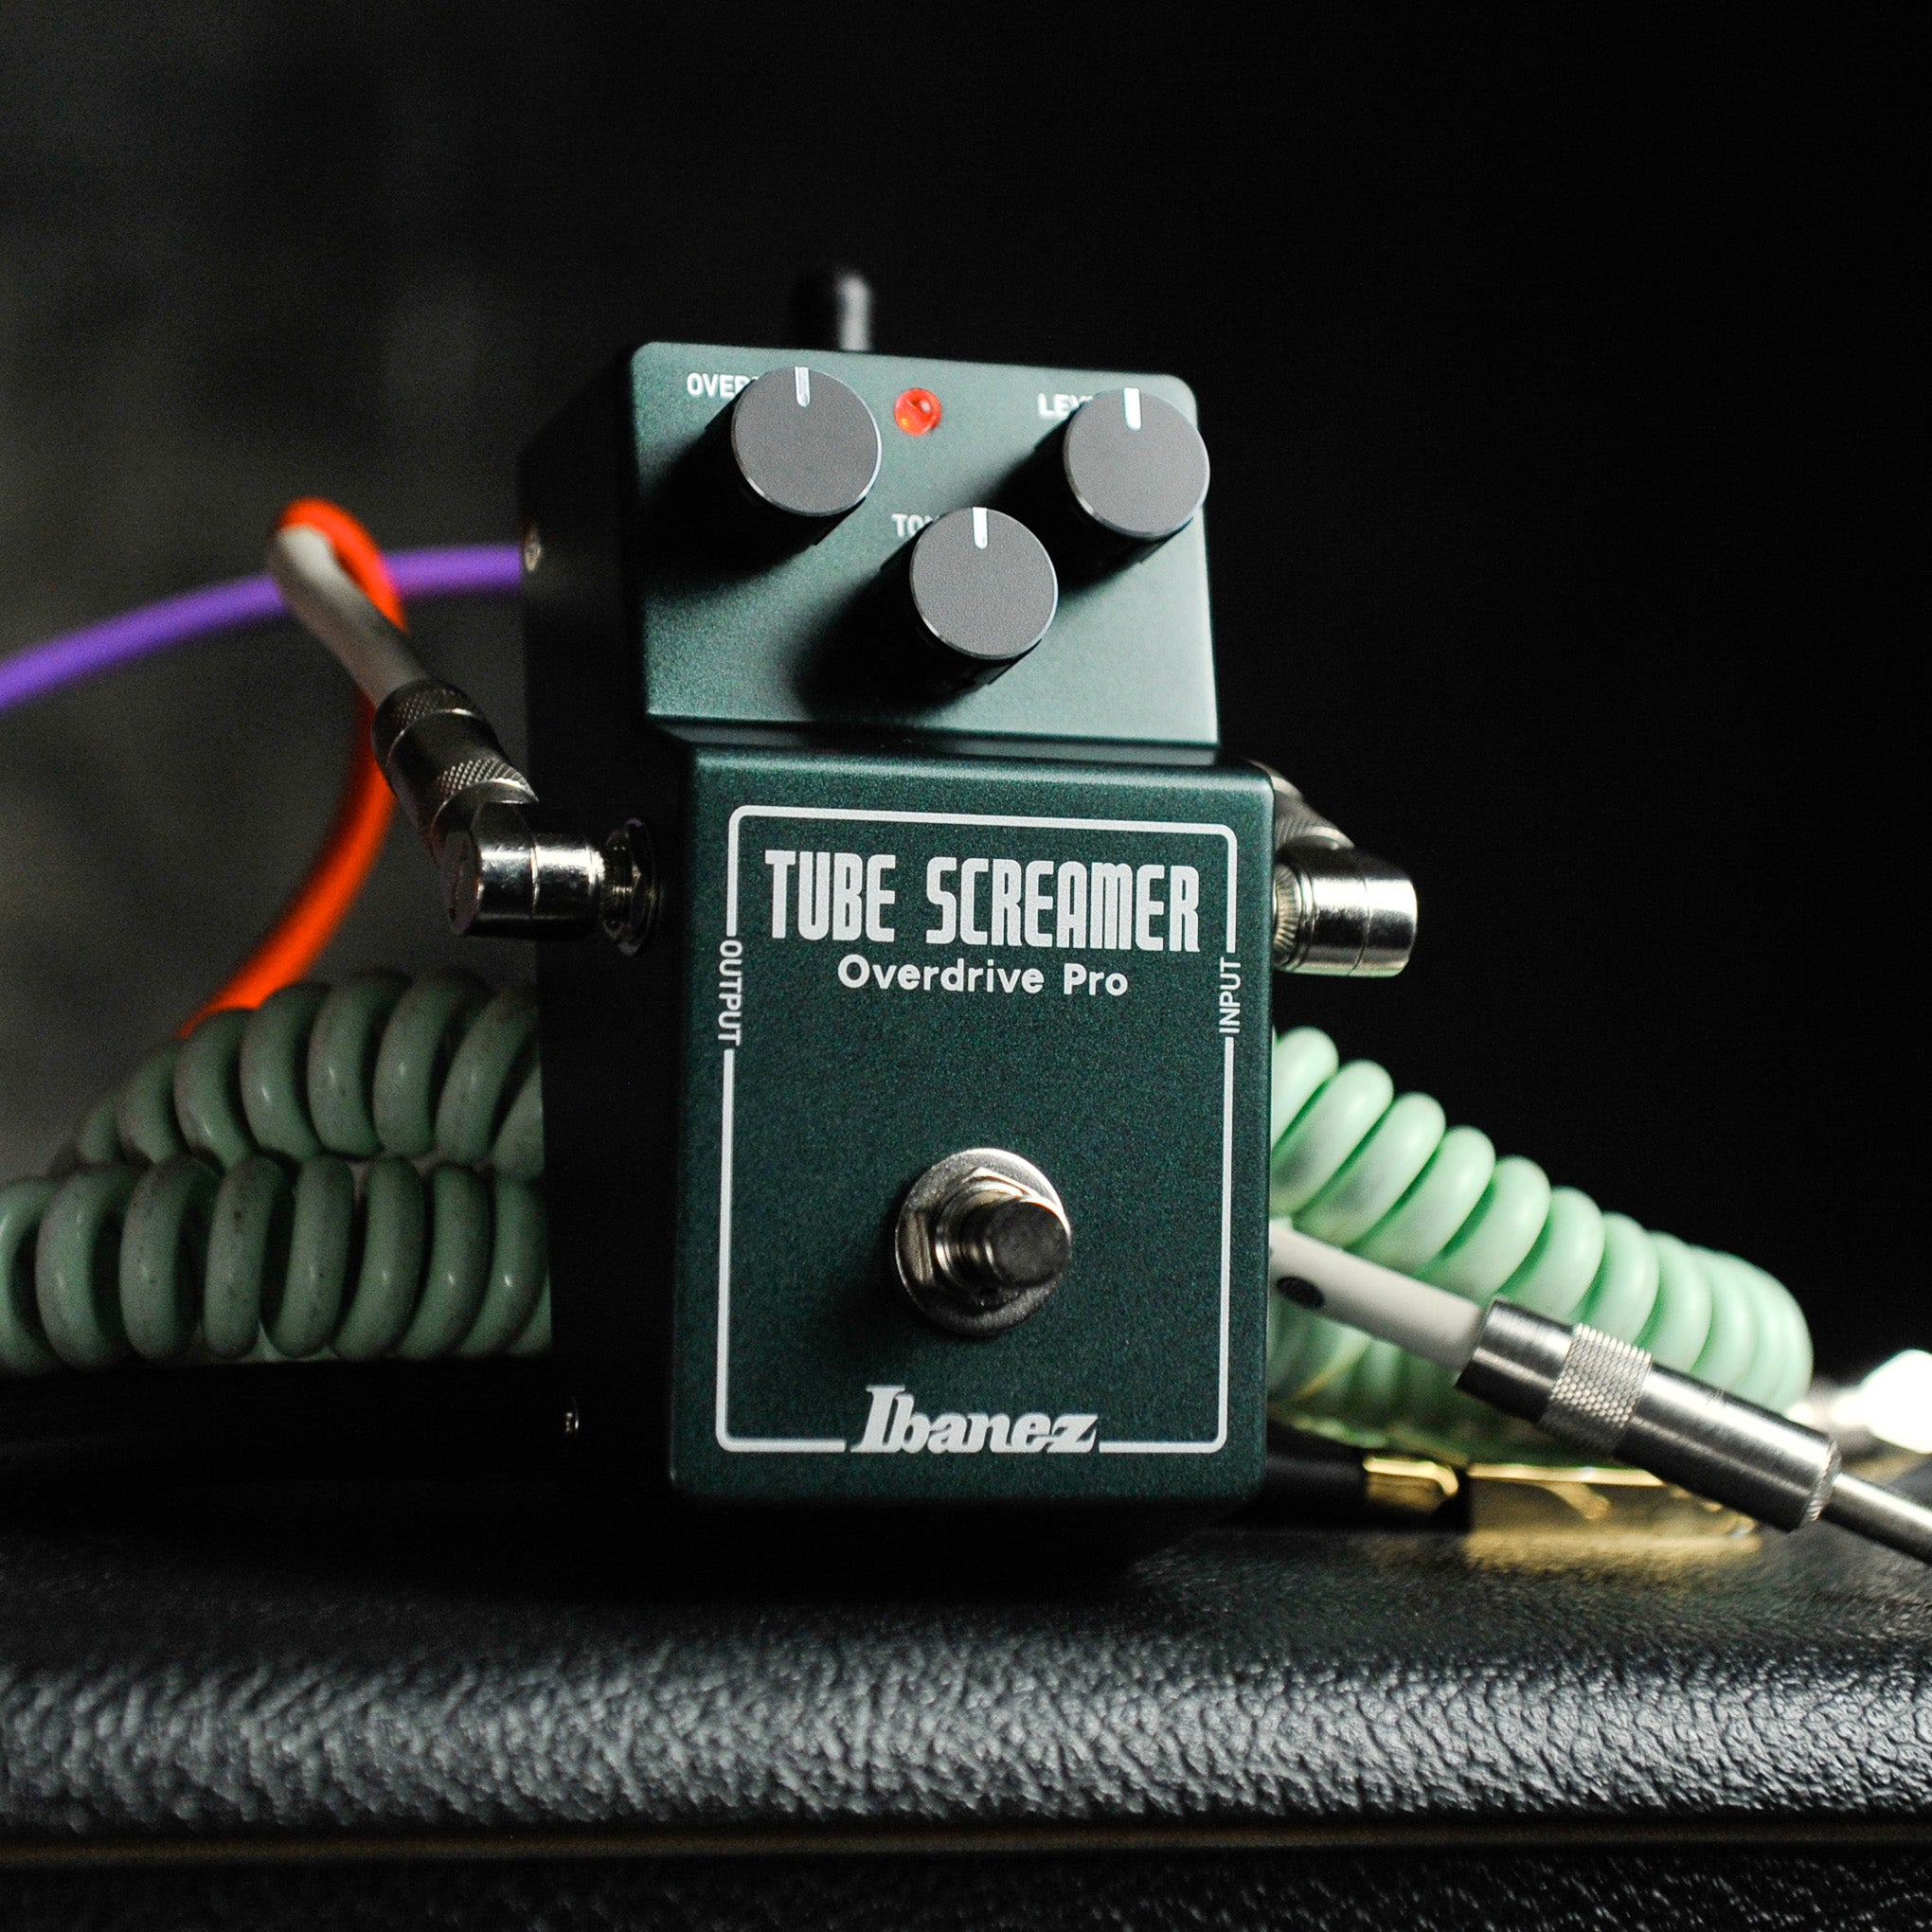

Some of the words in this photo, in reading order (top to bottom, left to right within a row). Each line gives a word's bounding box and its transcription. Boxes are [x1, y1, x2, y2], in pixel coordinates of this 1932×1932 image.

[687, 372, 759, 398] OVER
[1038, 393, 1093, 419] LEV
[764, 849, 897, 943] TUBE
[925, 856, 1201, 953] SCREAMER
[718, 939, 742, 1046] OUTPUT
[837, 954, 1045, 994] Overdrive
[1063, 962, 1129, 996] Pro
[1219, 956, 1242, 1034] INPUT
[850, 1385, 1099, 1454] Ibanez
